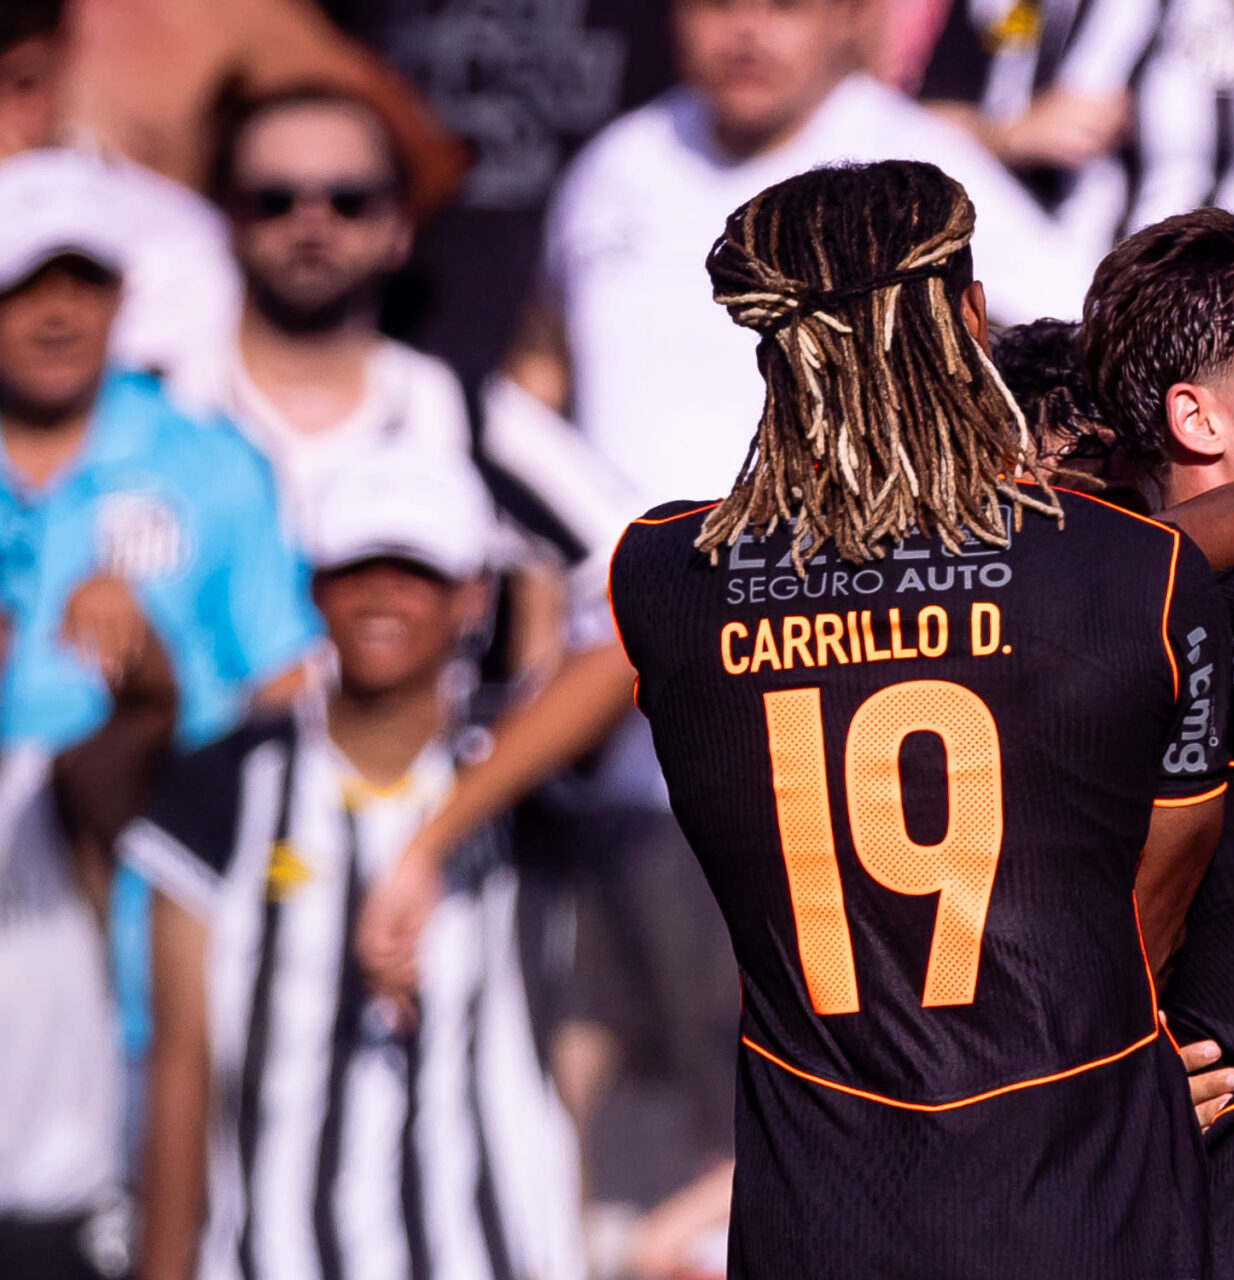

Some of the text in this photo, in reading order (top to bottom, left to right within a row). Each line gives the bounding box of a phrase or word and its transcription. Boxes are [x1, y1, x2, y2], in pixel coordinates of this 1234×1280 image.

[726, 562, 1013, 605] SEGURO AUTO
[720, 602, 1012, 676] CARRILLO D.
[762, 679, 1004, 1015] 19
